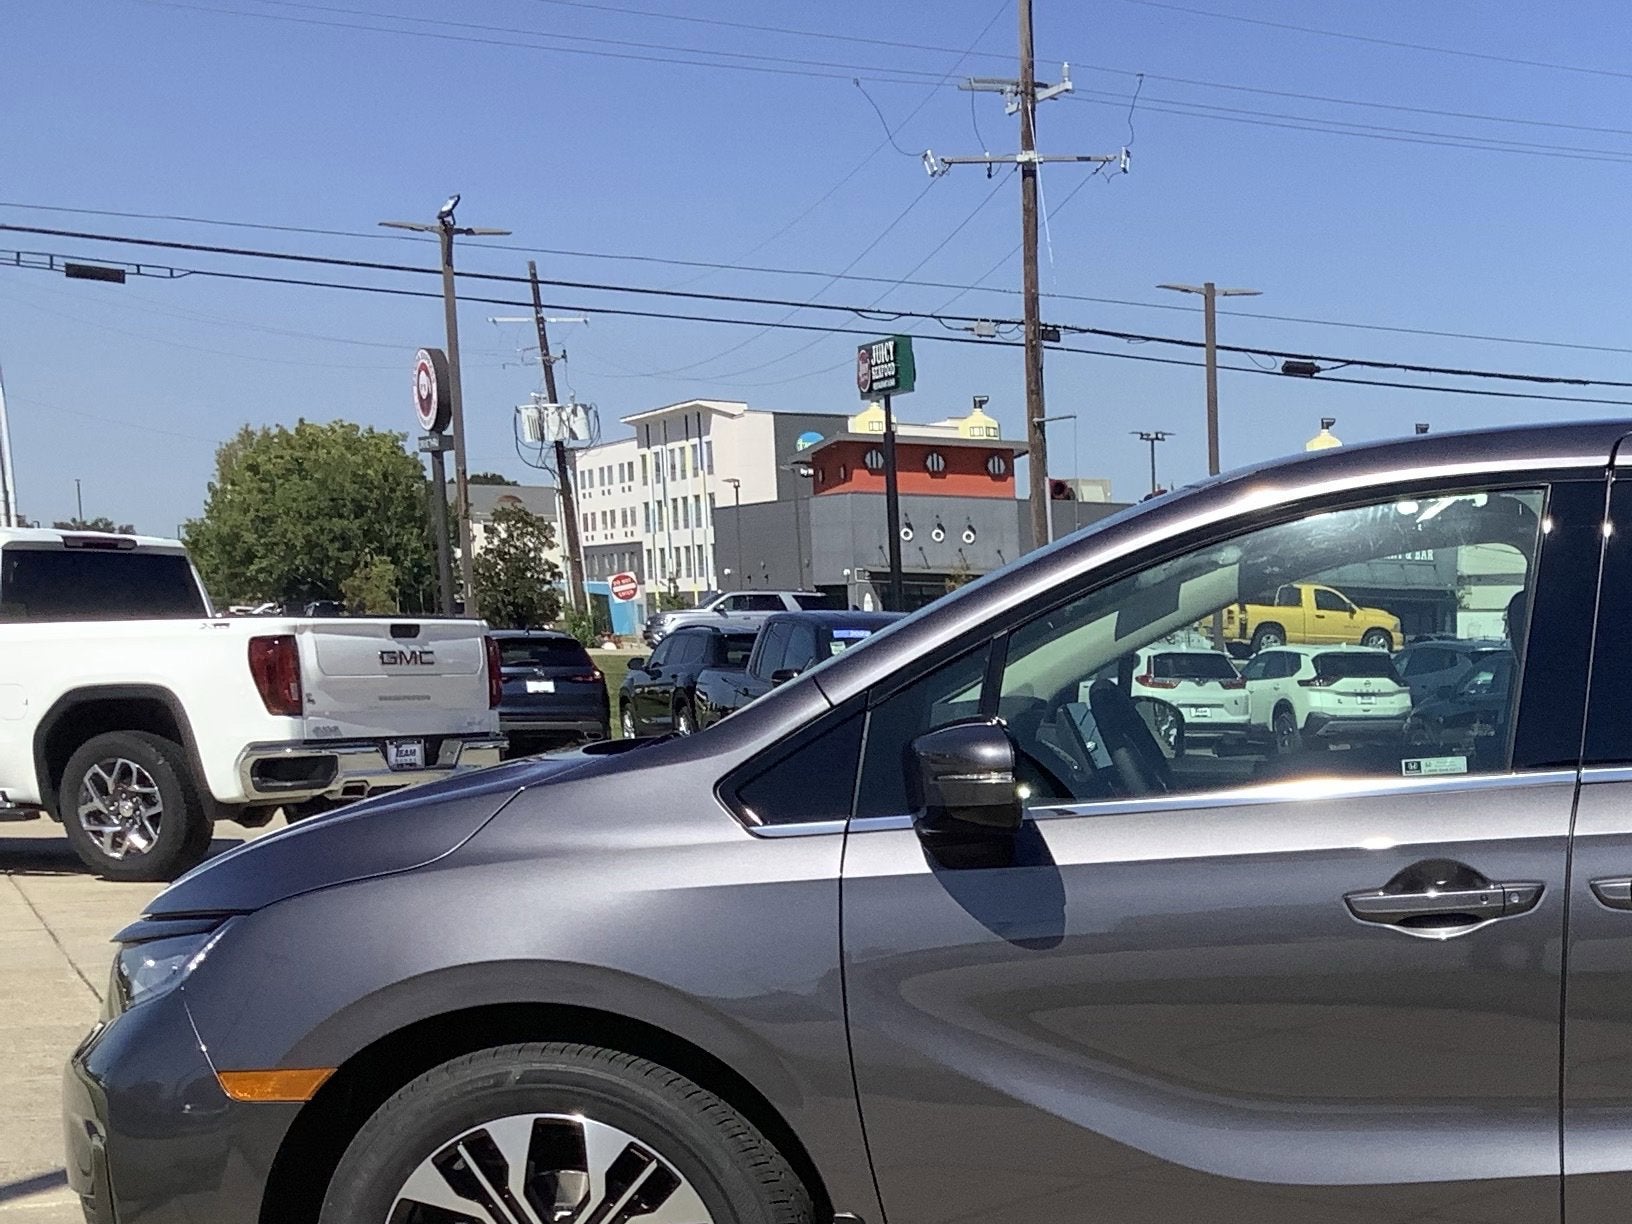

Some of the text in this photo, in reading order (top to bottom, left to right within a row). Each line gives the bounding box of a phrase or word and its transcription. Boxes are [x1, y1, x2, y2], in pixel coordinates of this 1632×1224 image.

[871, 340, 895, 366] JUICY
[1414, 549, 1434, 561] BAR
[380, 650, 435, 666] GMC
[396, 745, 417, 758] TEAM
